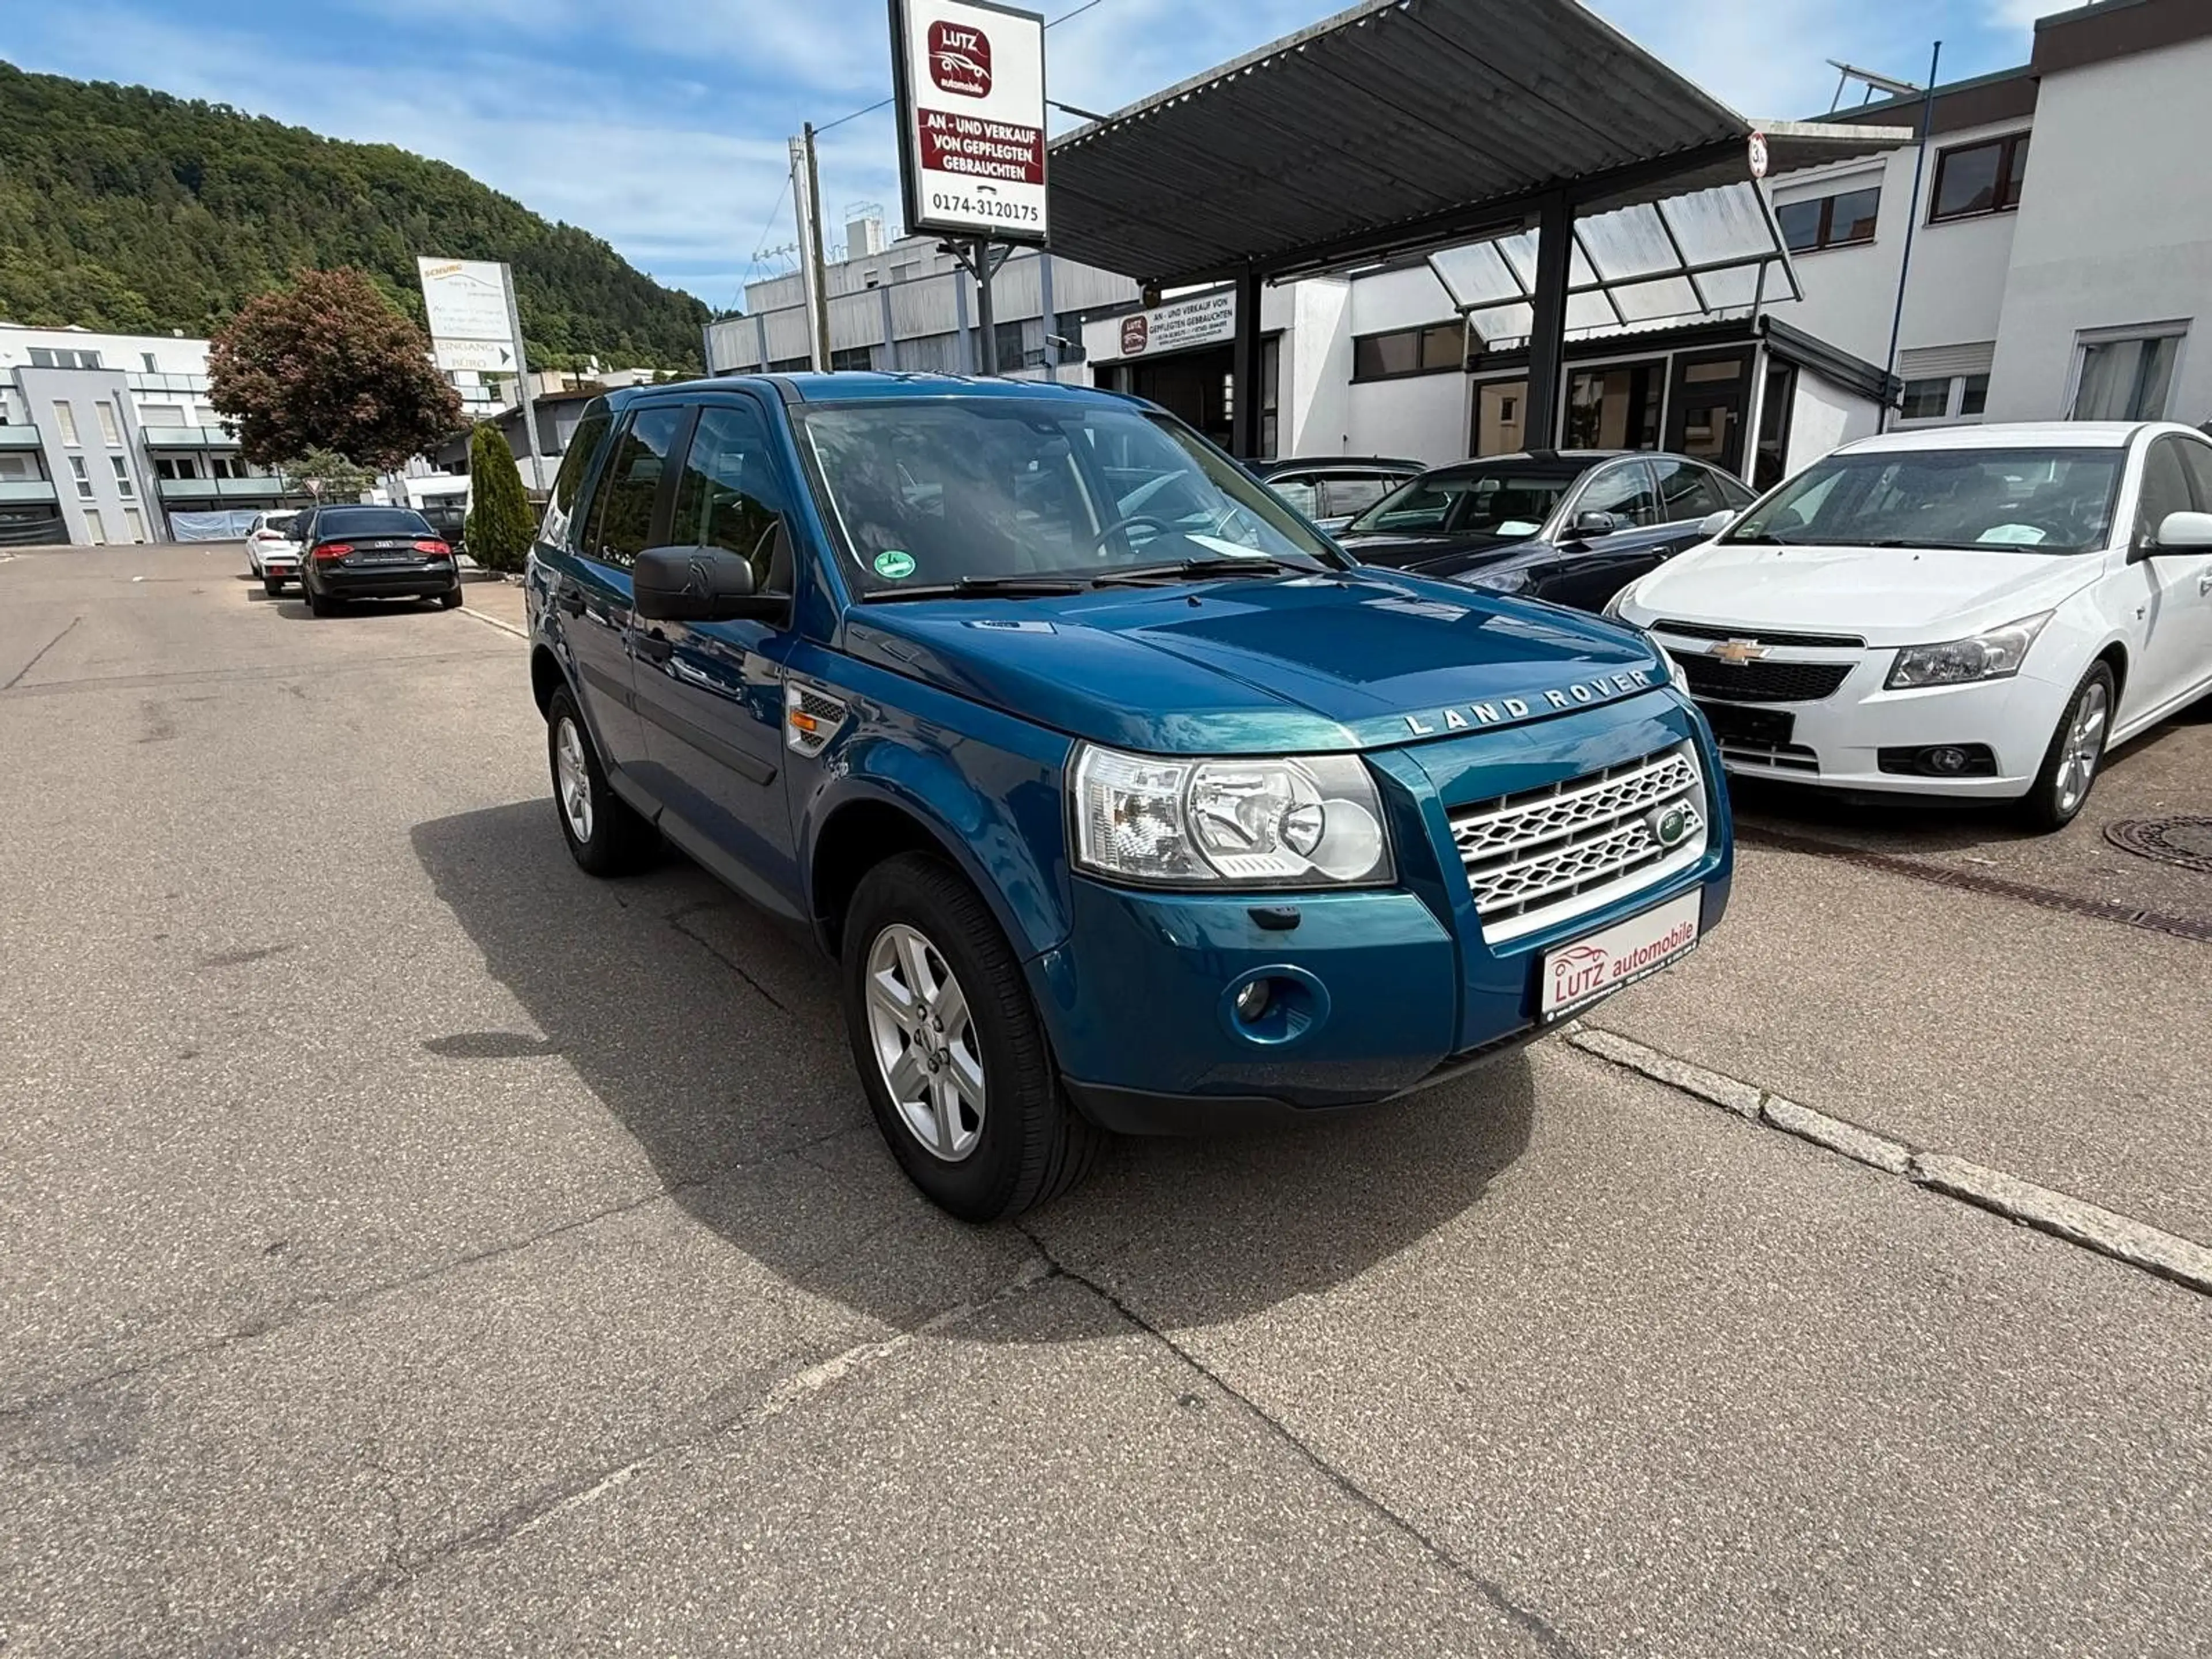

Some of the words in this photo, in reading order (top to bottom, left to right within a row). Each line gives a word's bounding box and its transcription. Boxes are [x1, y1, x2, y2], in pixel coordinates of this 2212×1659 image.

[942, 28, 978, 52] LUTZ
[956, 118, 982, 136] UND
[983, 122, 1037, 145] VERKAUF
[932, 133, 961, 152] VON
[963, 138, 1033, 163] GEPFLEGTEN
[942, 154, 1026, 180] GEBRAUCHTEN
[933, 193, 1039, 222] 0174-3120175
[1182, 300, 1211, 316] VERKAUF
[1213, 298, 1229, 309] VON
[1404, 698, 1529, 736] LAND
[1544, 669, 1652, 709] ROVER
[1555, 961, 1605, 1003] LUTZ
[1612, 921, 1694, 978] automobile
